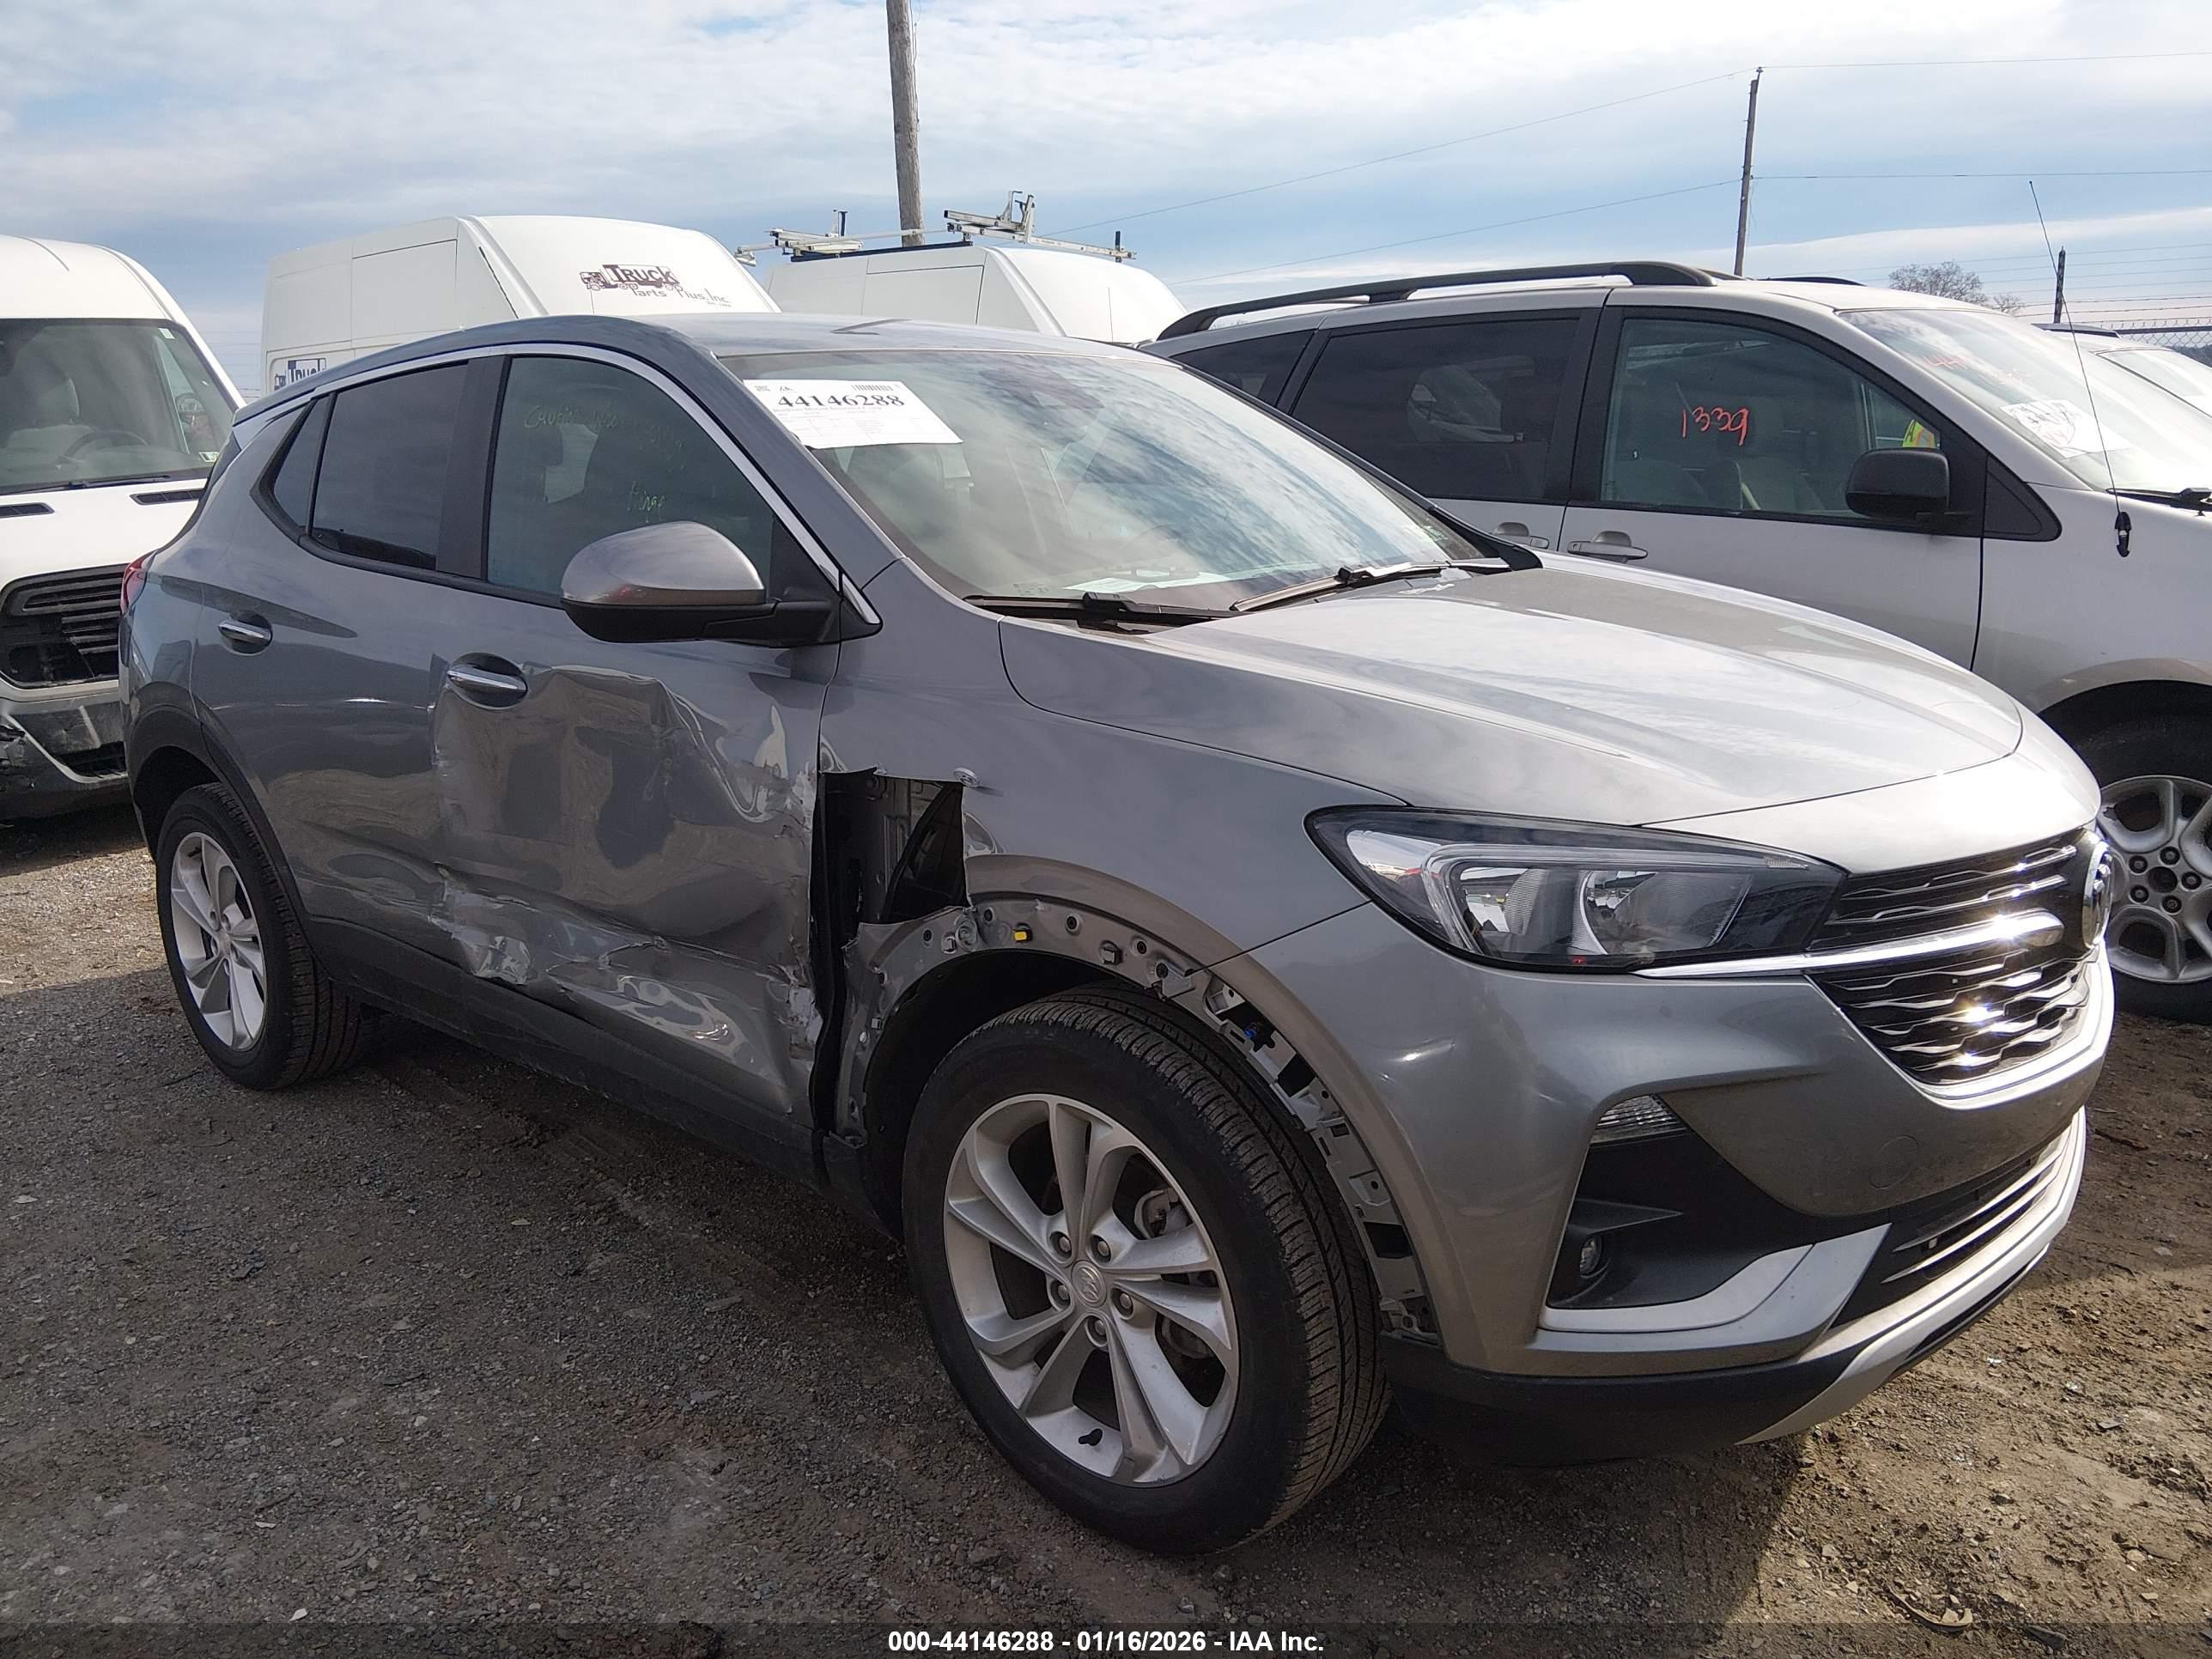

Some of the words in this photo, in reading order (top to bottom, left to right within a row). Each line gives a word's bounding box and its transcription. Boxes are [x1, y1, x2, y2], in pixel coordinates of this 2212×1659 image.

[630, 285, 666, 297] Parts
[778, 394, 904, 407] 44146288
[1682, 405, 1749, 447] 1339
